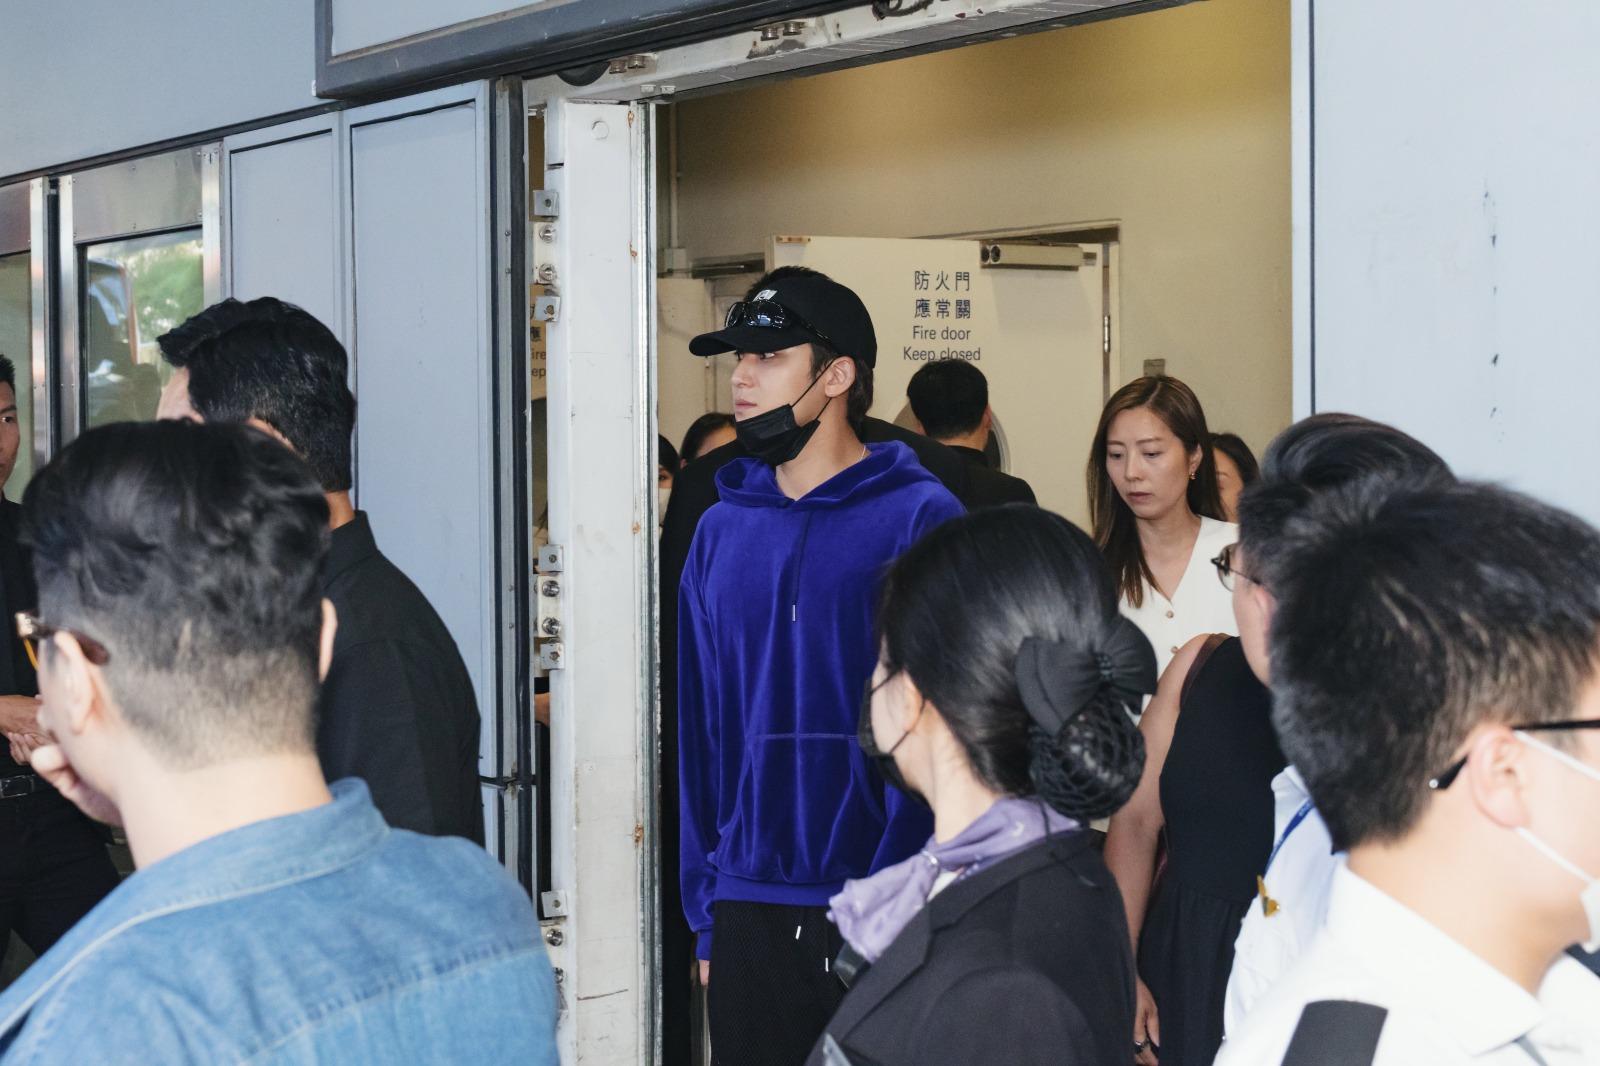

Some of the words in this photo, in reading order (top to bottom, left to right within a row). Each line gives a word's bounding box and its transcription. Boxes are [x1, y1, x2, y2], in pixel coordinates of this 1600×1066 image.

[914, 270, 970, 291] 防火門
[914, 298, 971, 319] 應常關
[913, 325, 937, 340] Fire
[941, 325, 971, 340] door
[531, 348, 546, 360] ire
[903, 346, 935, 362] Keep
[939, 346, 981, 361] closed
